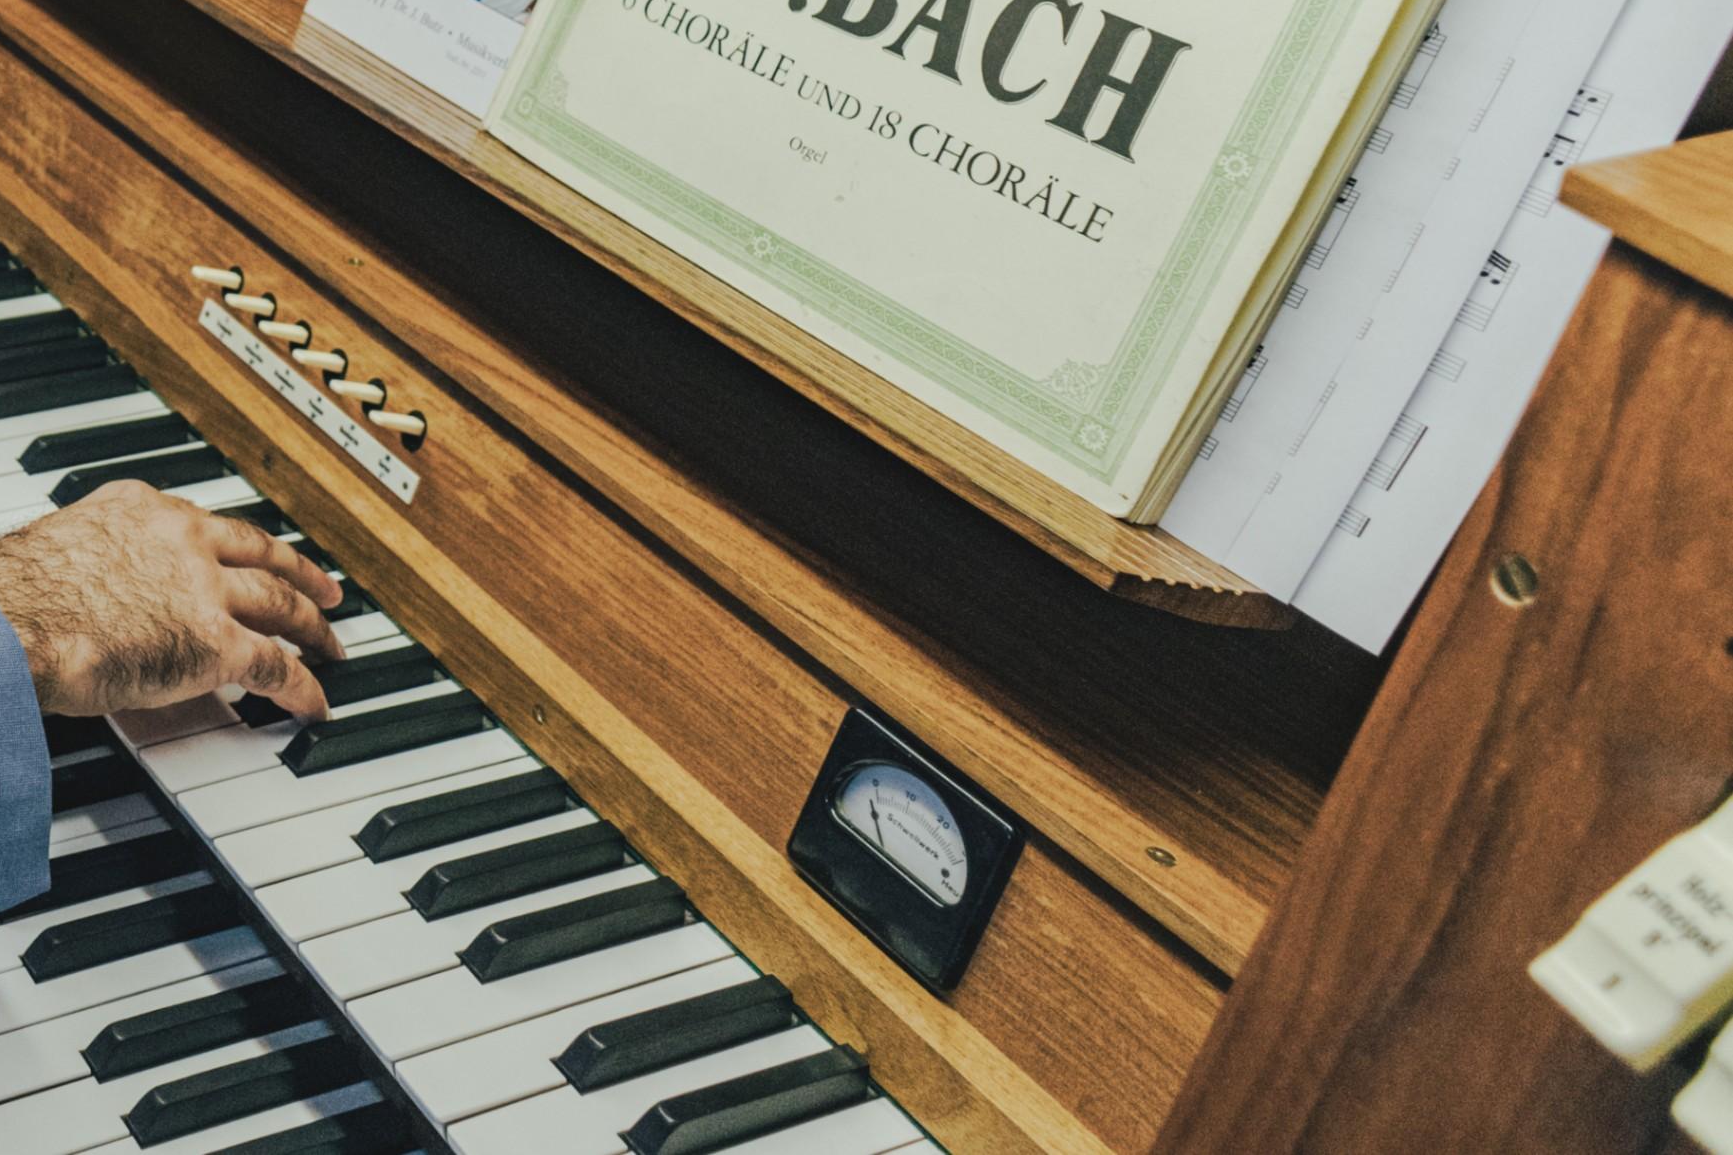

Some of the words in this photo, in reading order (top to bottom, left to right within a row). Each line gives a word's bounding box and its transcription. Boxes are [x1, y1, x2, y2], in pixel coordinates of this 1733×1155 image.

[788, 136, 828, 165] Orgel
[797, 74, 863, 124] UND
[868, 104, 903, 140] 18
[908, 122, 1115, 243] CHORÄLE
[872, 778, 880, 787] 0
[906, 790, 917, 802] 10
[937, 814, 951, 830] 20
[887, 812, 940, 860] Schwellwerk
